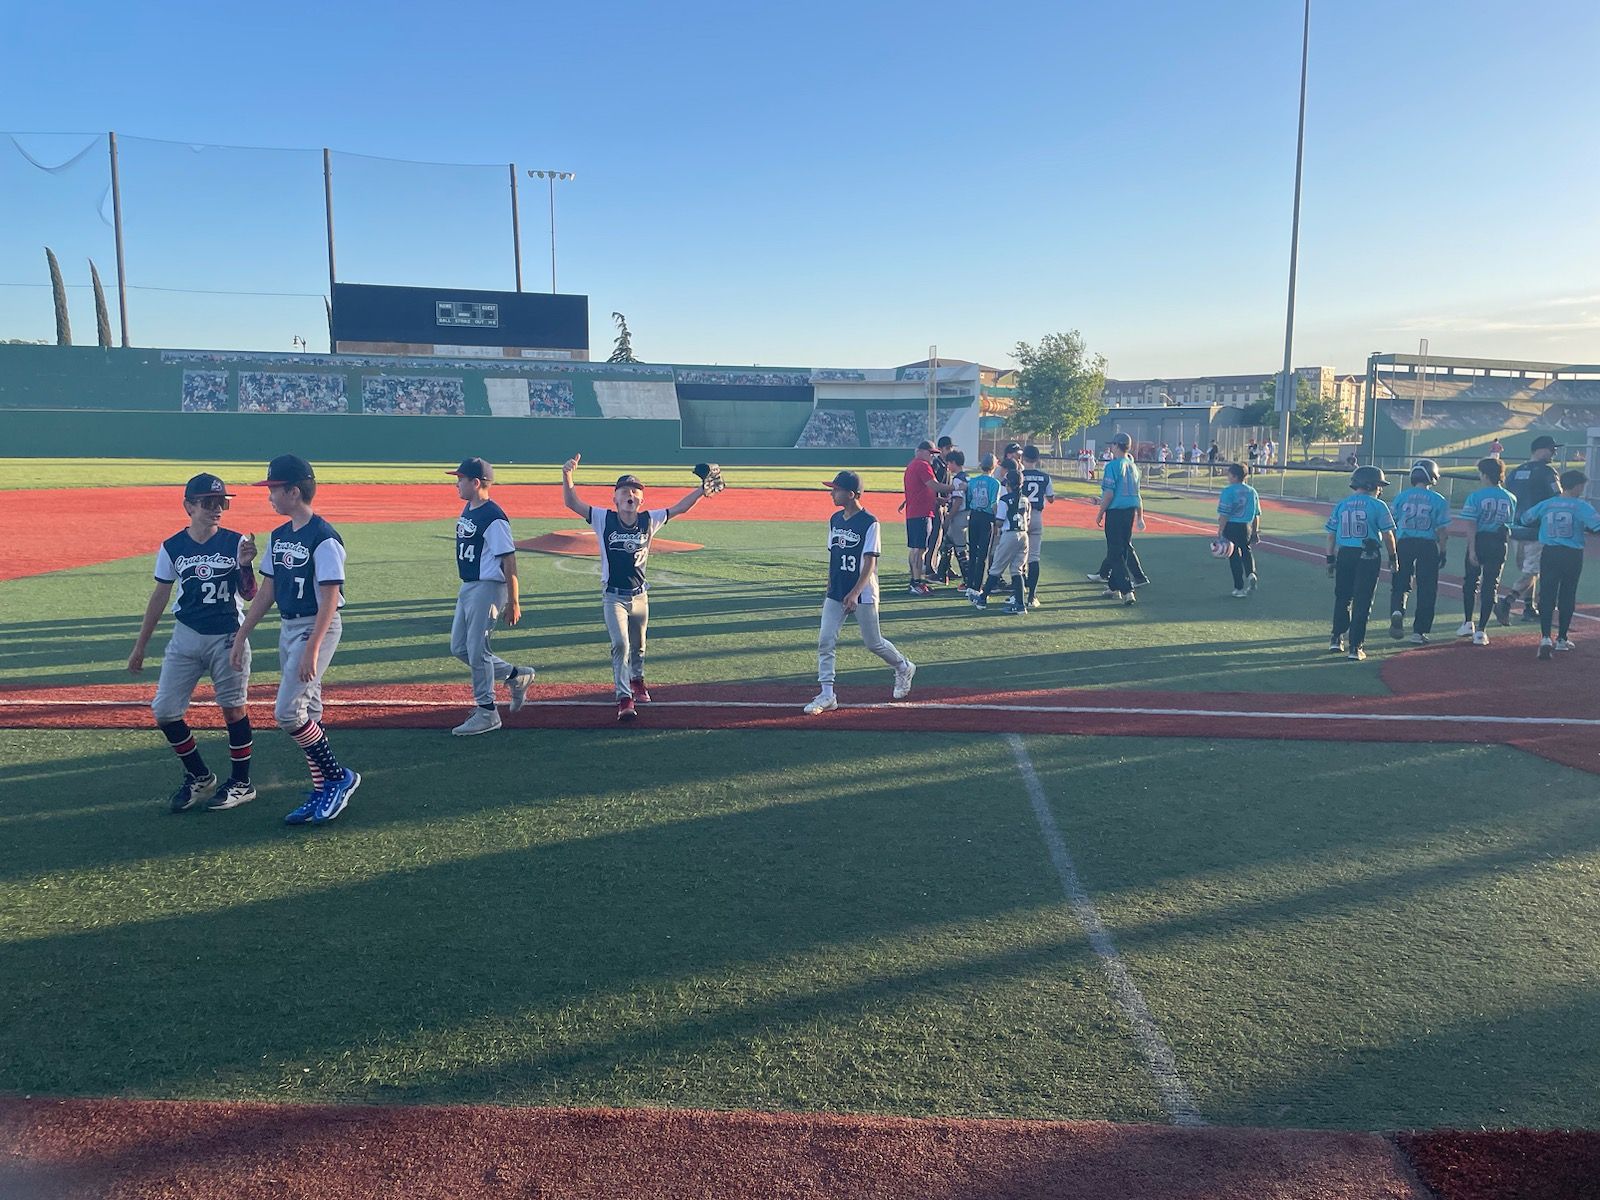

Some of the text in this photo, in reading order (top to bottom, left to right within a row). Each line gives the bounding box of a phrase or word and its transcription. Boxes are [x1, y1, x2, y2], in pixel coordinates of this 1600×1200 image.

[1027, 482, 1039, 503] 2
[1341, 510, 1368, 538] 16
[1401, 503, 1432, 530] 25
[458, 542, 475, 562] 14
[175, 553, 236, 574] Crusaders
[840, 555, 856, 572] 13
[201, 581, 230, 604] 24
[294, 577, 305, 599] 7
